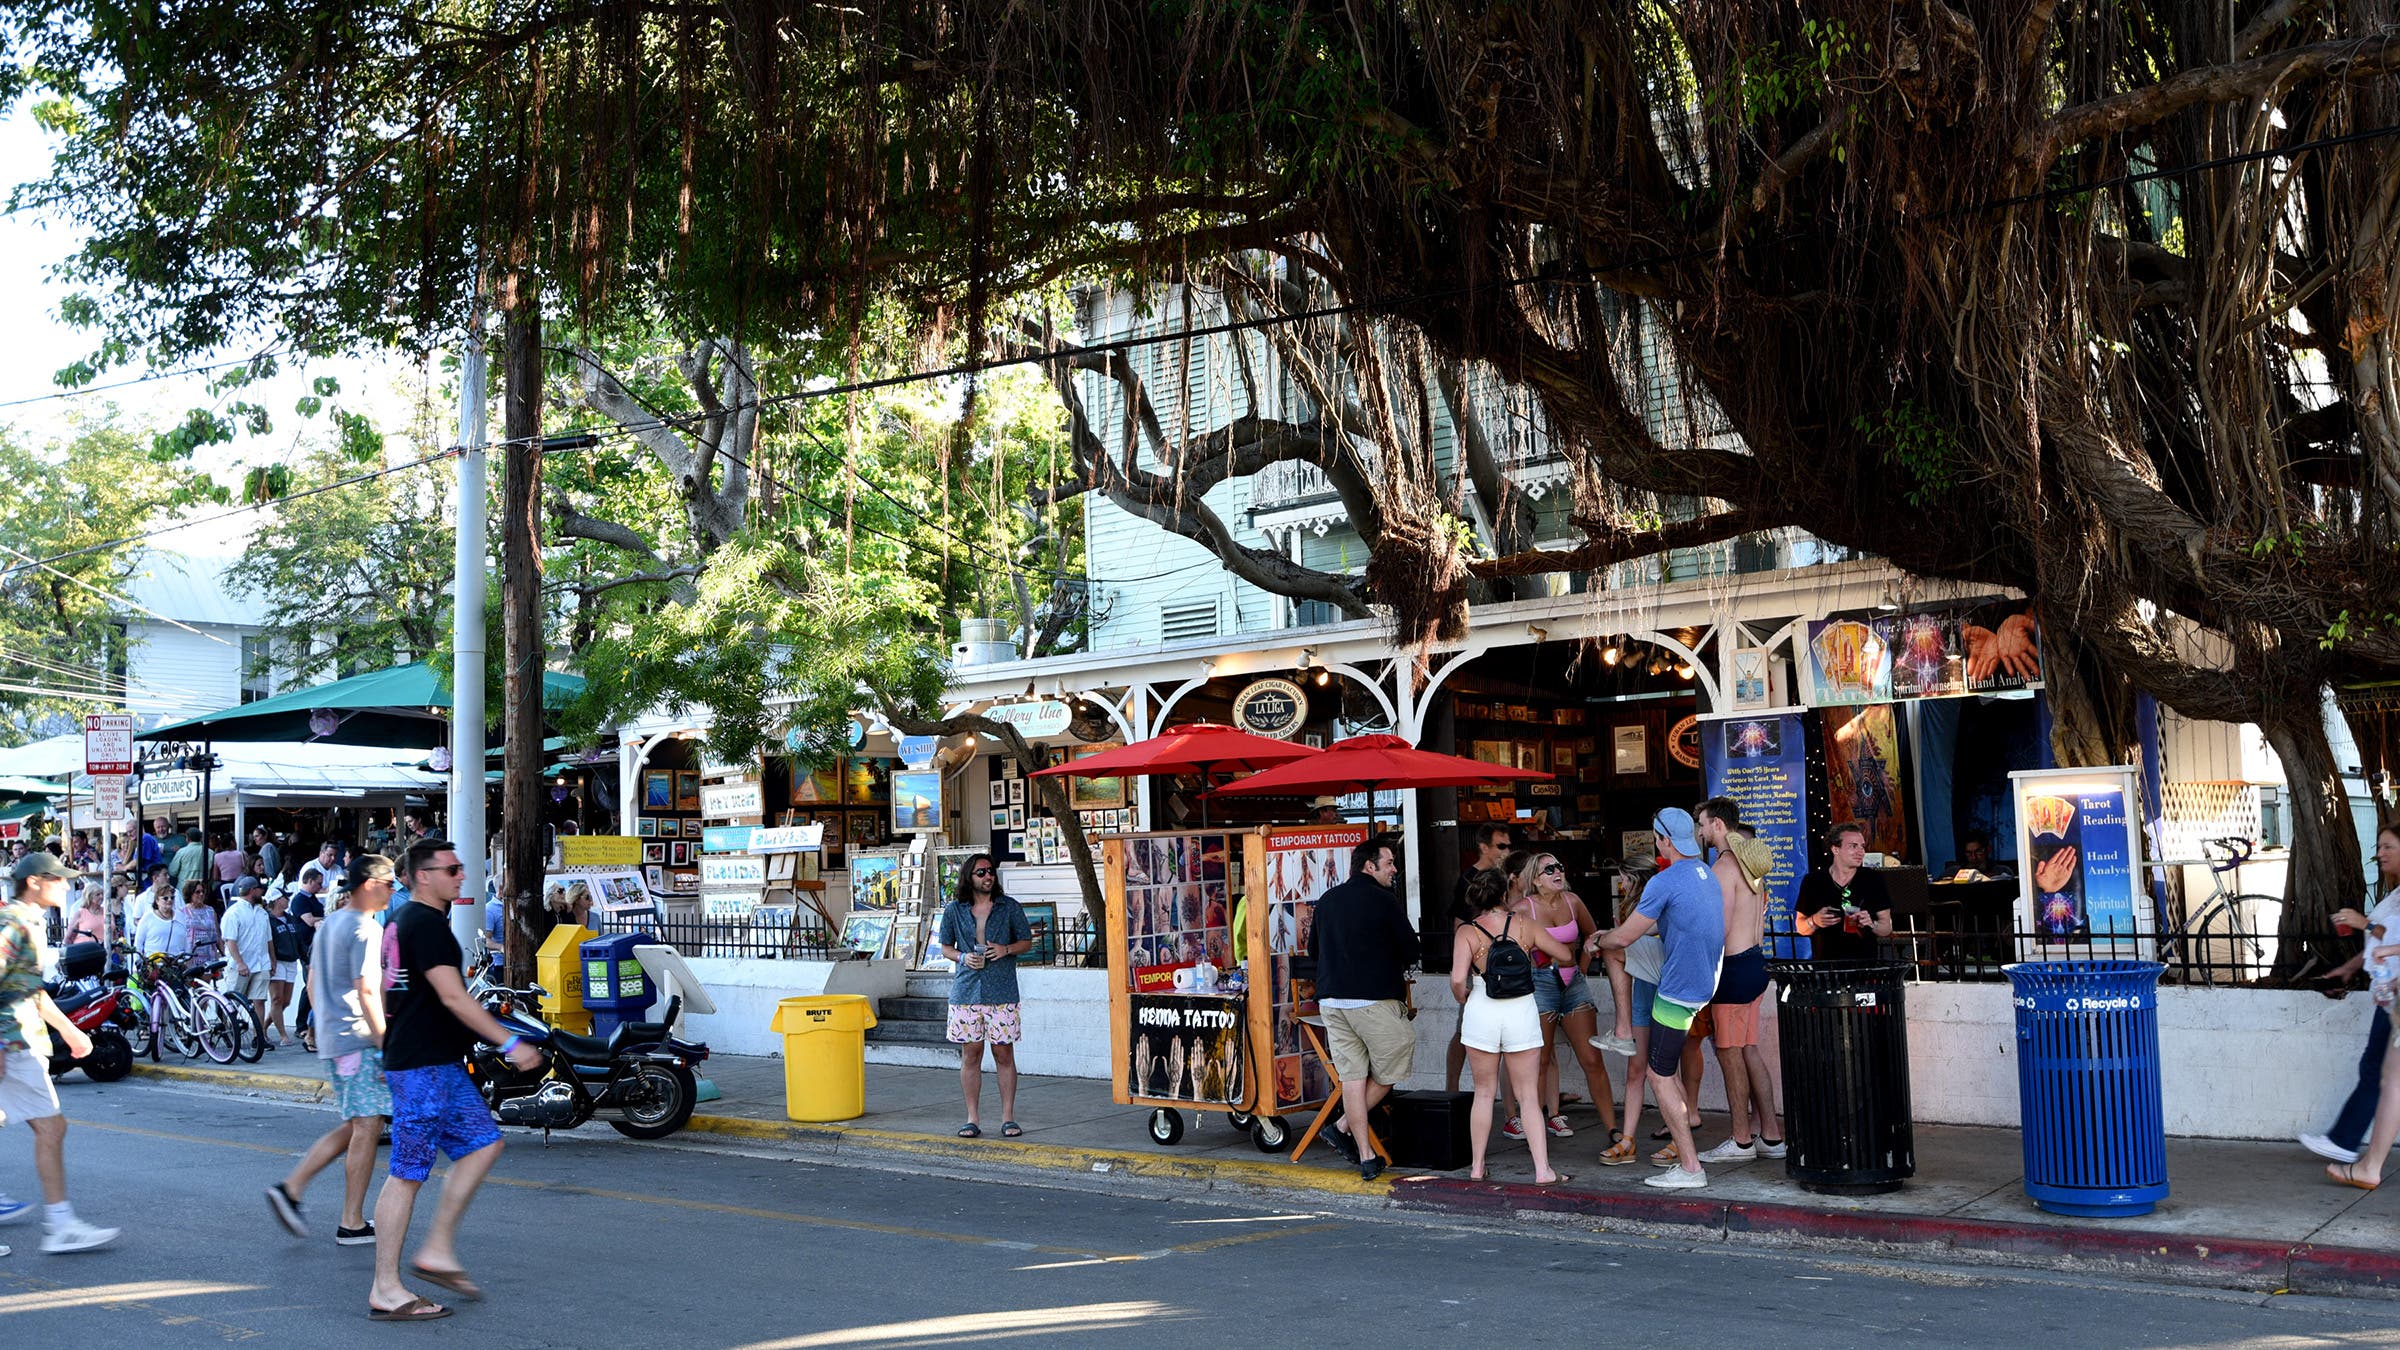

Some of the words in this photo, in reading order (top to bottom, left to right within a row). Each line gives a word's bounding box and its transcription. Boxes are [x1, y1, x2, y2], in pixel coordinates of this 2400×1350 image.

[1876, 622, 1895, 633] Over
[1893, 680, 1923, 697] Spiritual
[1925, 677, 1964, 694] Counseling
[1968, 674, 1995, 690] Hand
[1250, 684, 1264, 693] LEAF
[1265, 681, 1283, 689] CIGAR
[1283, 683, 1304, 706] FACTORY
[989, 708, 1033, 724] Gallery
[1039, 704, 1063, 720] Uno
[1255, 703, 1266, 714] LA
[1267, 702, 1285, 714] LIGA
[87, 717, 100, 729] NO
[1279, 721, 1299, 737] CIGARS
[89, 763, 115, 771] TOW-AWAY
[116, 763, 129, 771] ZONE
[2081, 798, 2111, 810] Tarot
[1270, 834, 1322, 847] TEMPORARY
[1324, 832, 1361, 844] TATTOOS
[2087, 851, 2118, 861] Hand
[706, 864, 761, 880] FLORIDA
[2087, 895, 2129, 912] Spiritual
[1139, 971, 1173, 984] TEMPOR
[590, 982, 608, 994] see
[620, 980, 642, 993] see
[2082, 998, 2128, 1010] Recycle
[1139, 1006, 1181, 1027] HENNA
[1184, 1009, 1236, 1029] TATTOO
